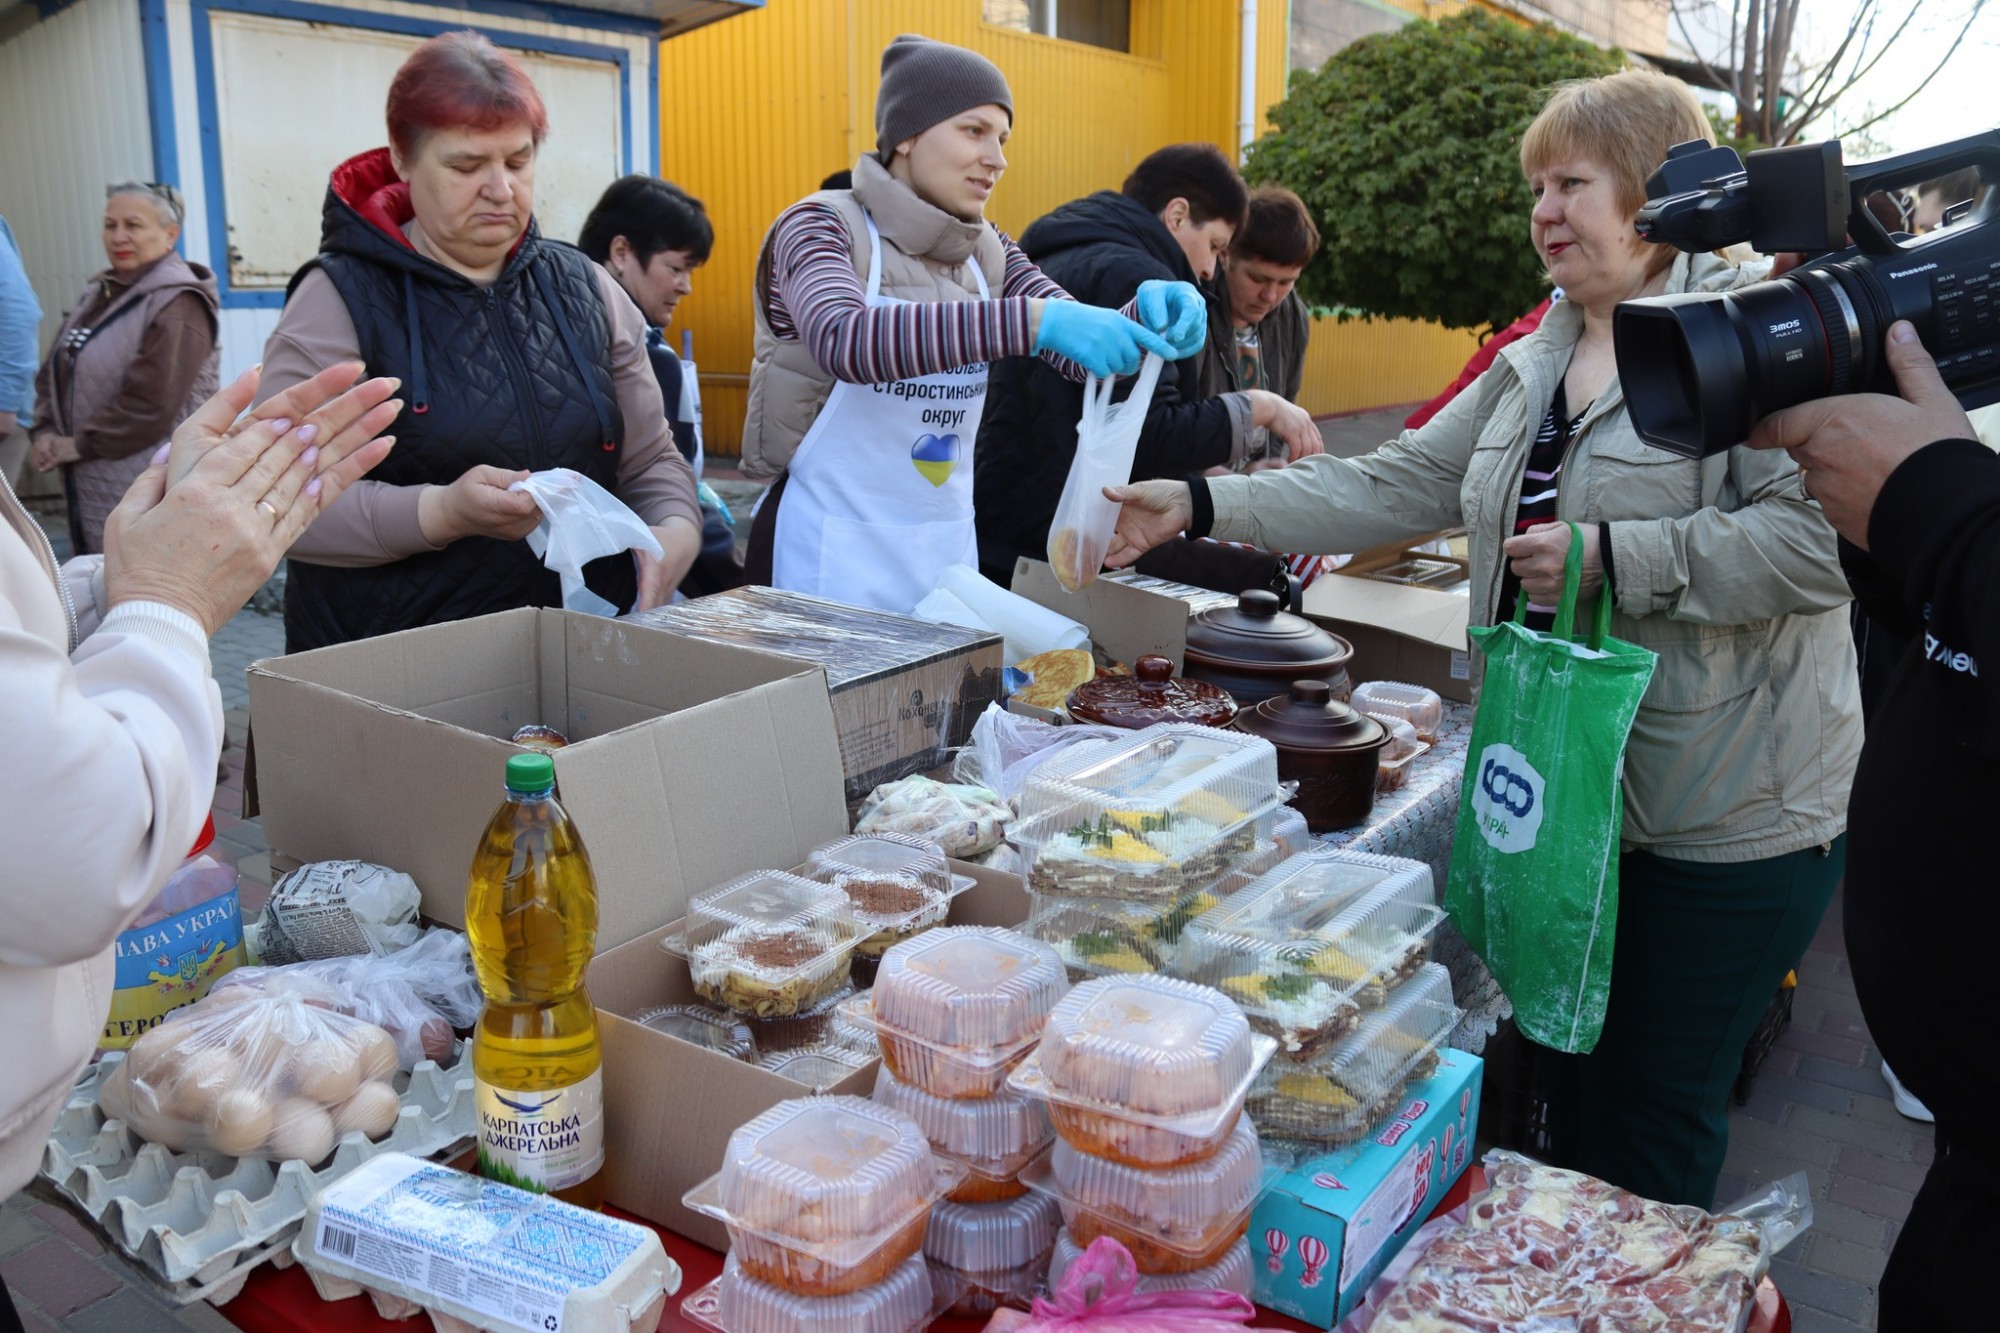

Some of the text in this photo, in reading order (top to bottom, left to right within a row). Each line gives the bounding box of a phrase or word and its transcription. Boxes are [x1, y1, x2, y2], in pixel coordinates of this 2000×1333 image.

[1889, 263, 1938, 279] Panasonic
[922, 408, 966, 428] округ
[483, 1111, 580, 1138] КАРПАТСЬКА
[485, 1131, 580, 1154] ДЖЕРЕЛЬНА
